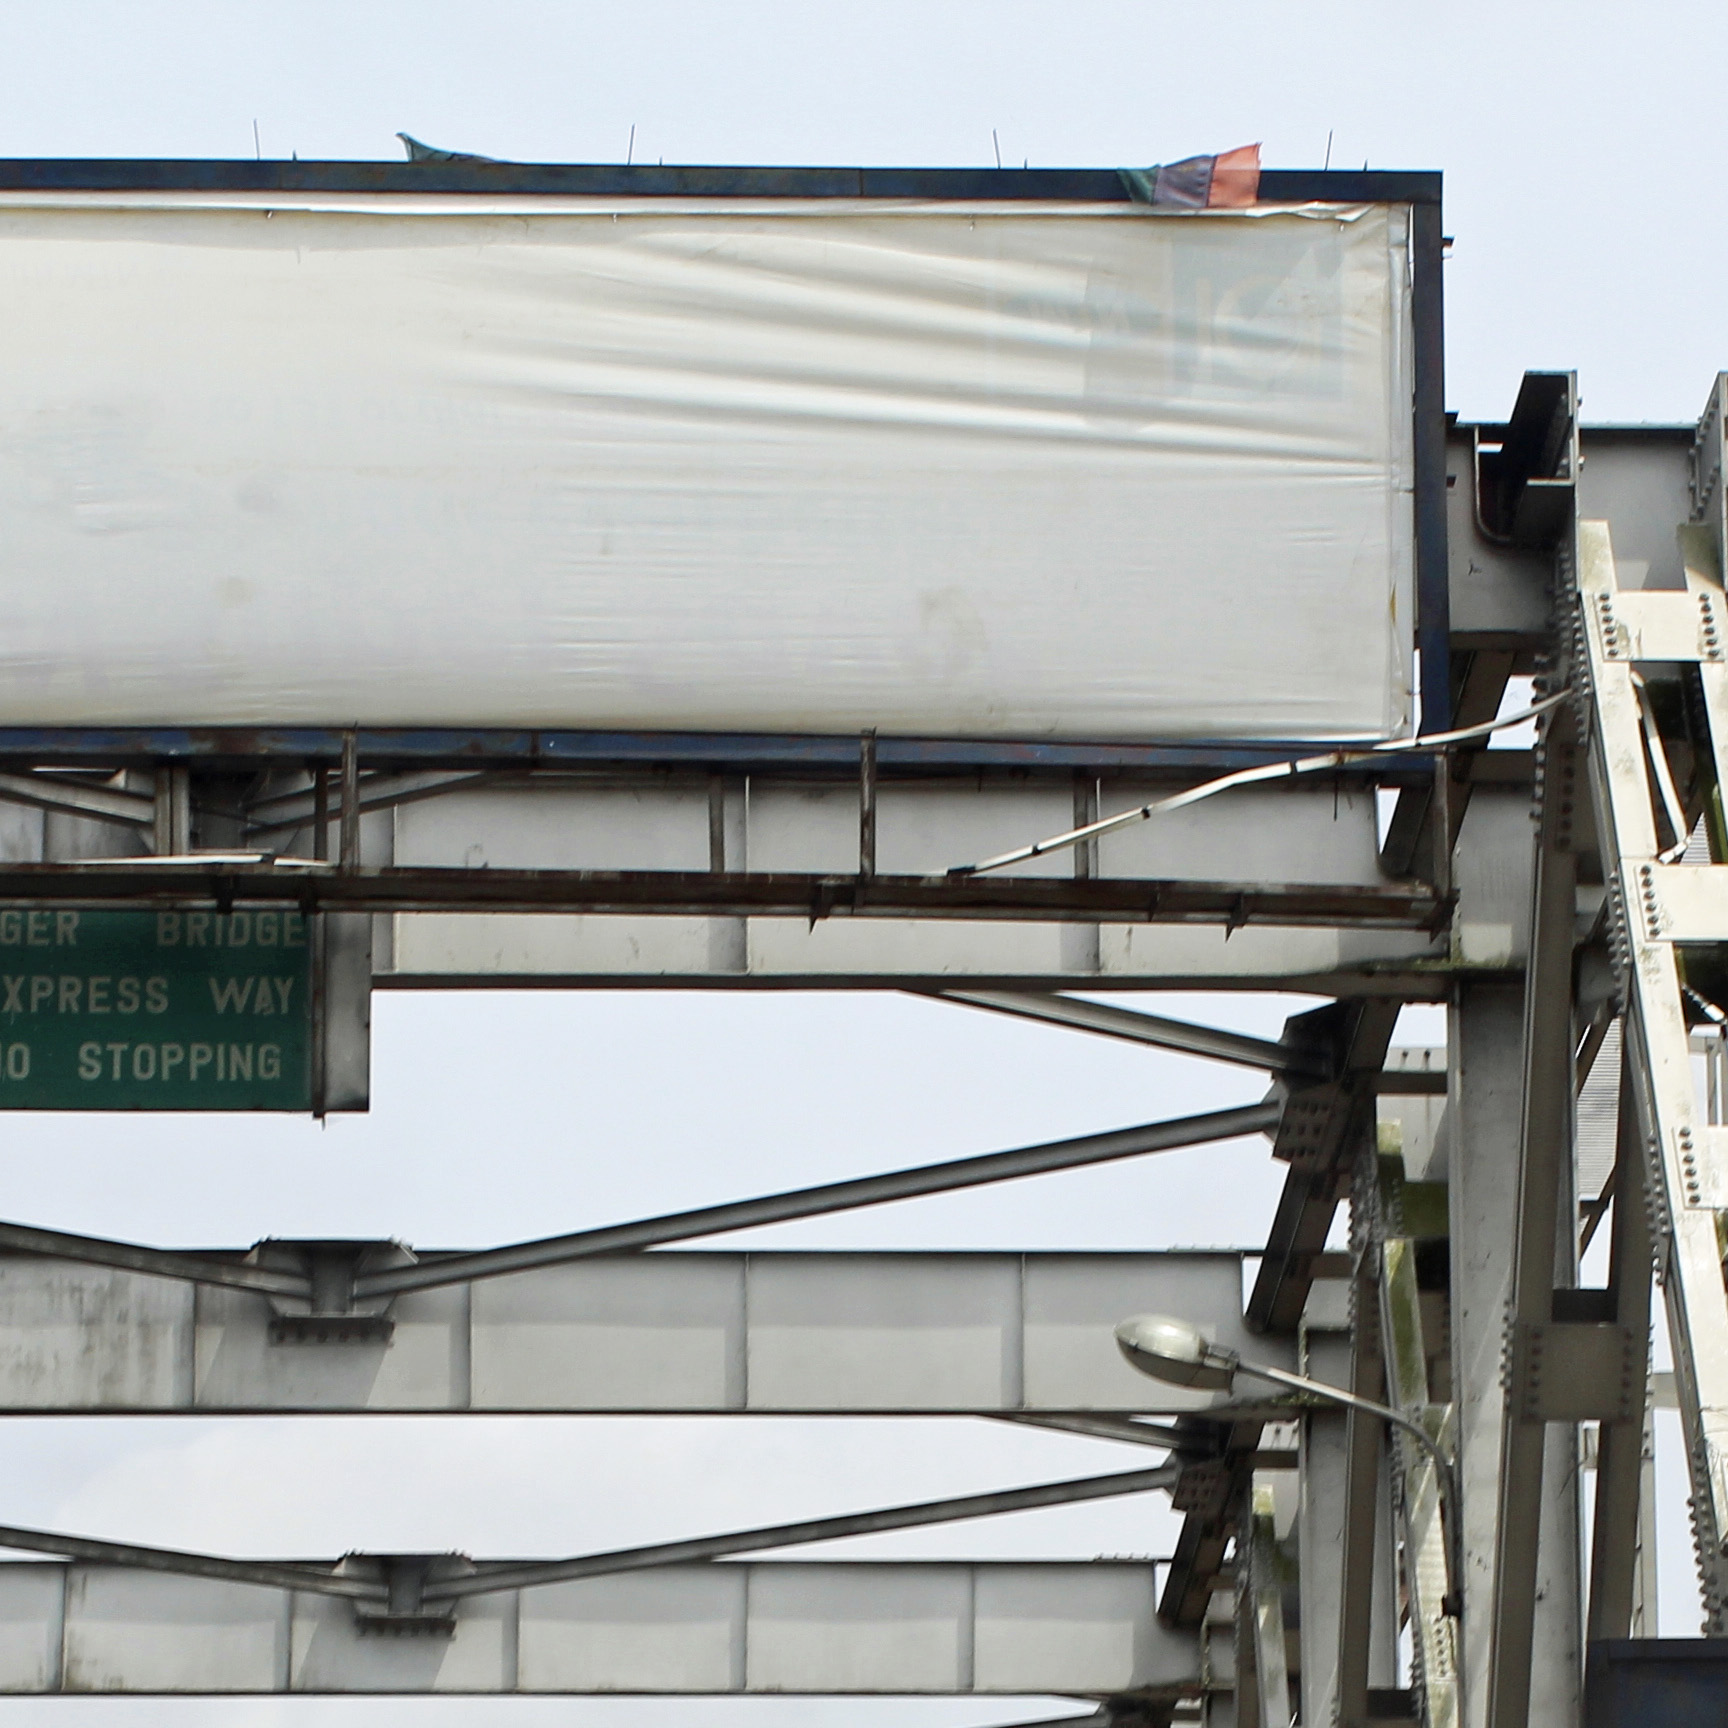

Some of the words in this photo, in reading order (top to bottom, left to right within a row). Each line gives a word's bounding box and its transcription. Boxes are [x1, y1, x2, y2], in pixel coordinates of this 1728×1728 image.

[156, 912, 306, 947] BRIDGE
[210, 976, 296, 1016] WAY
[78, 1043, 282, 1081] STOPPING
